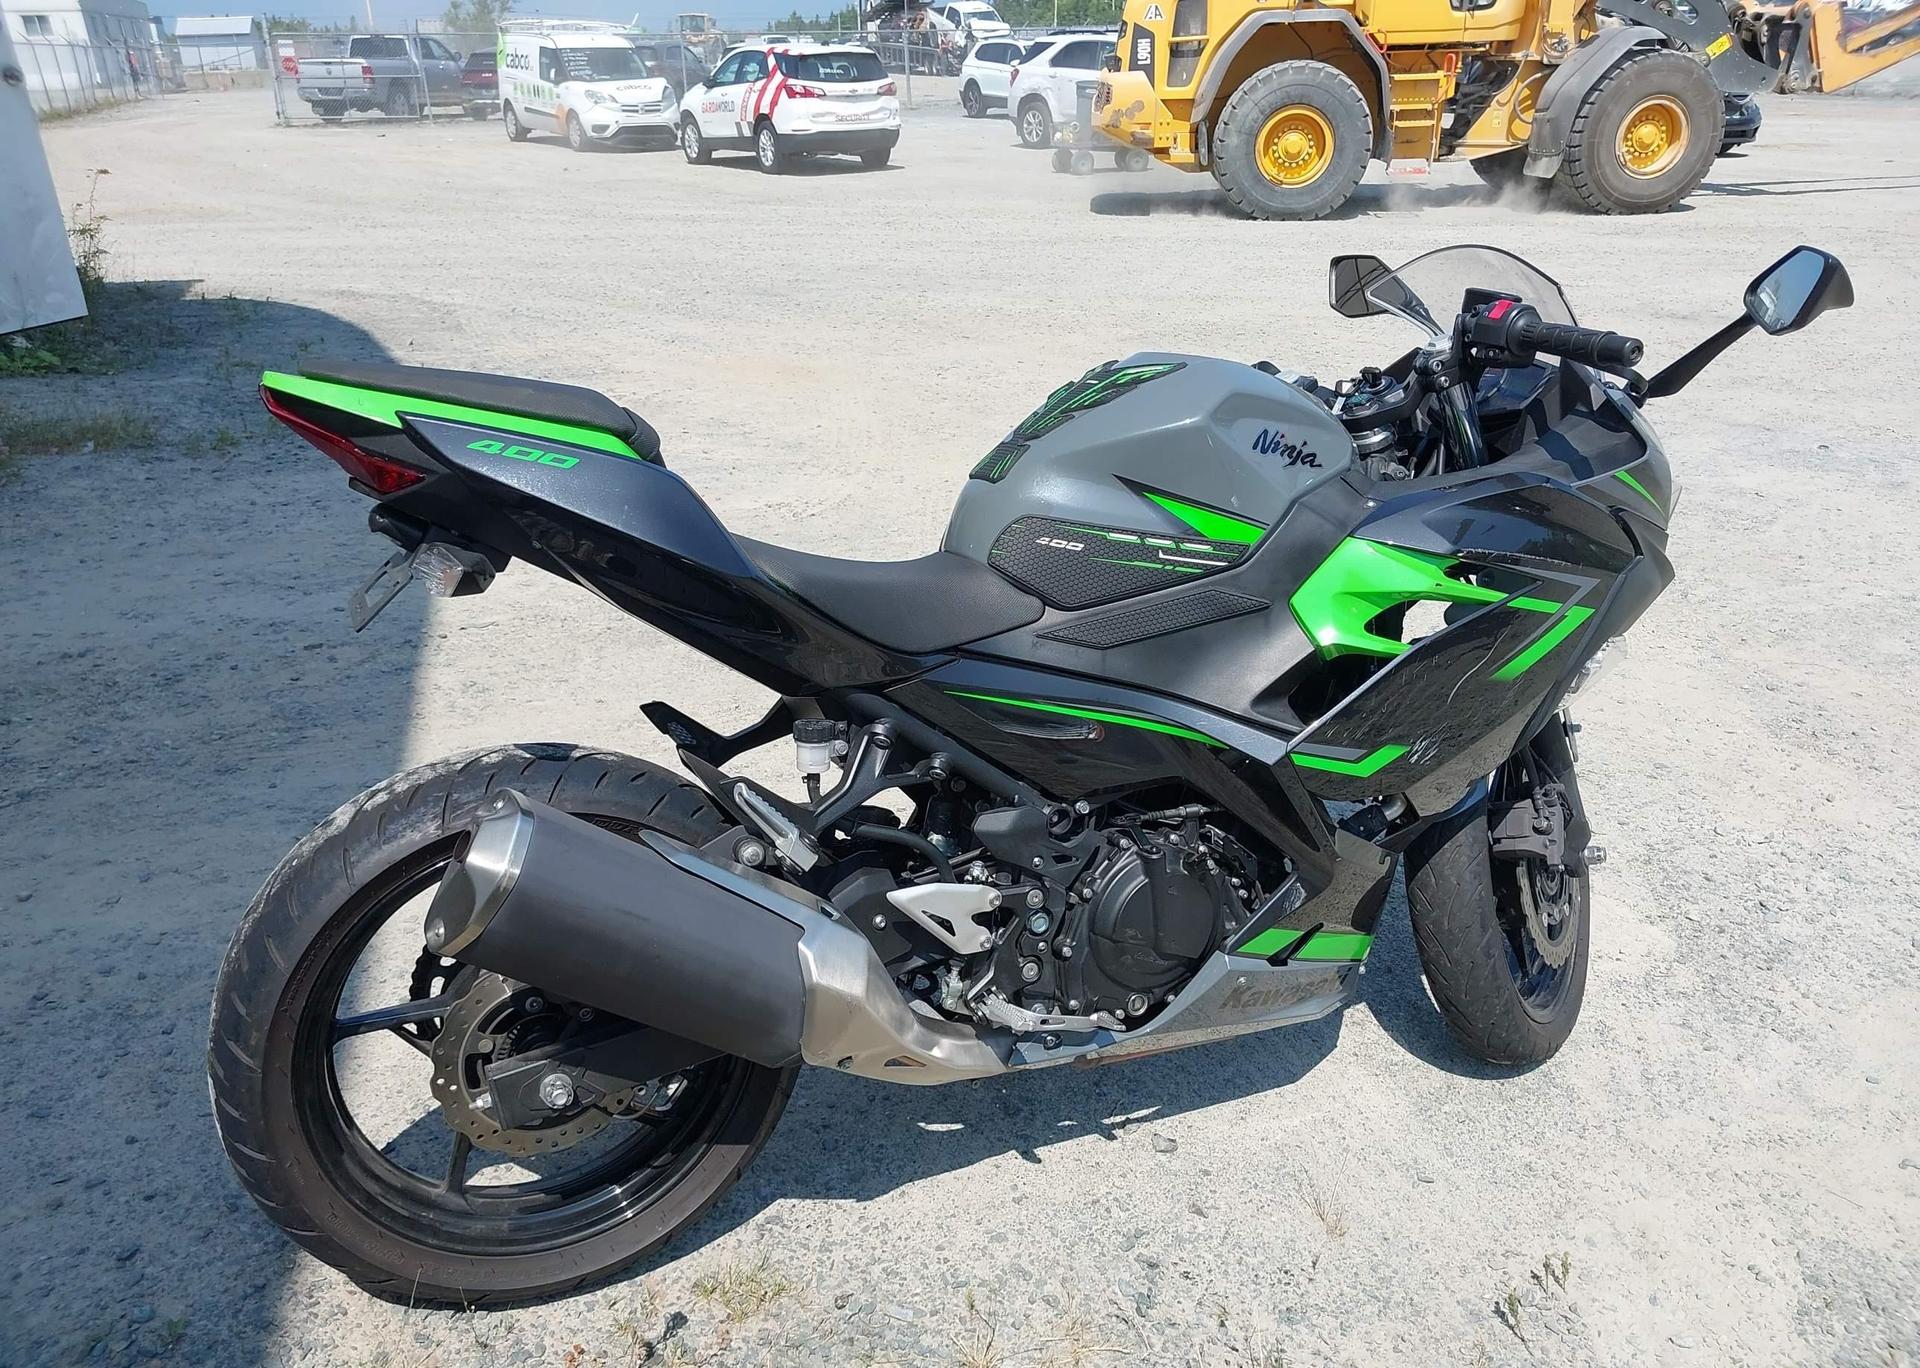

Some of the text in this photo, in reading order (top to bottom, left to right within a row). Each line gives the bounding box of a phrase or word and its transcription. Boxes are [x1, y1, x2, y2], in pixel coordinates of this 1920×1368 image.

[505, 48, 530, 70] cabco
[1137, 38, 1151, 65] L90H
[701, 100, 735, 113] GARDAWORLD
[466, 439, 580, 470] 400
[1252, 428, 1322, 469] Ninja
[1035, 537, 1085, 552] 400
